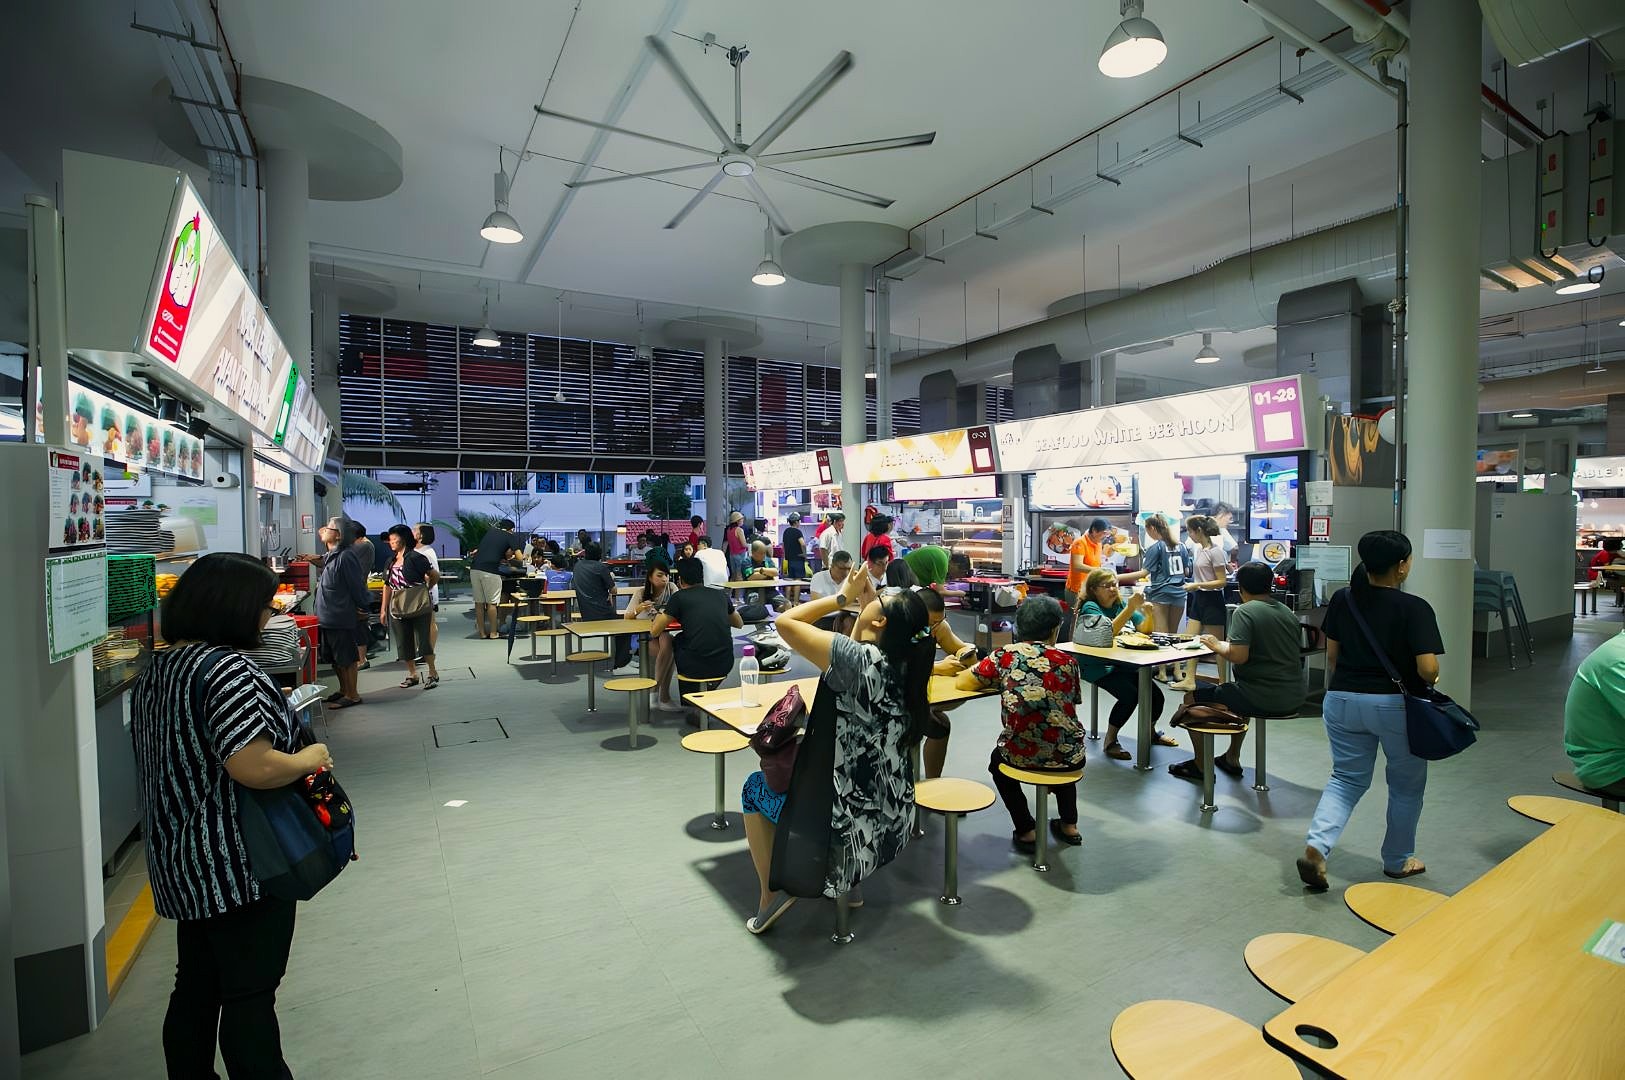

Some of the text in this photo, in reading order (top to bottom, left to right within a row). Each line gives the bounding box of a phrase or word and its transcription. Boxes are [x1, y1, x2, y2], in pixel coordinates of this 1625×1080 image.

[1254, 387, 1296, 405] 01-28
[1095, 426, 1142, 446] WHITE
[1148, 421, 1175, 440] BEE
[1179, 414, 1234, 437] HOON
[1169, 555, 1184, 575] 10
